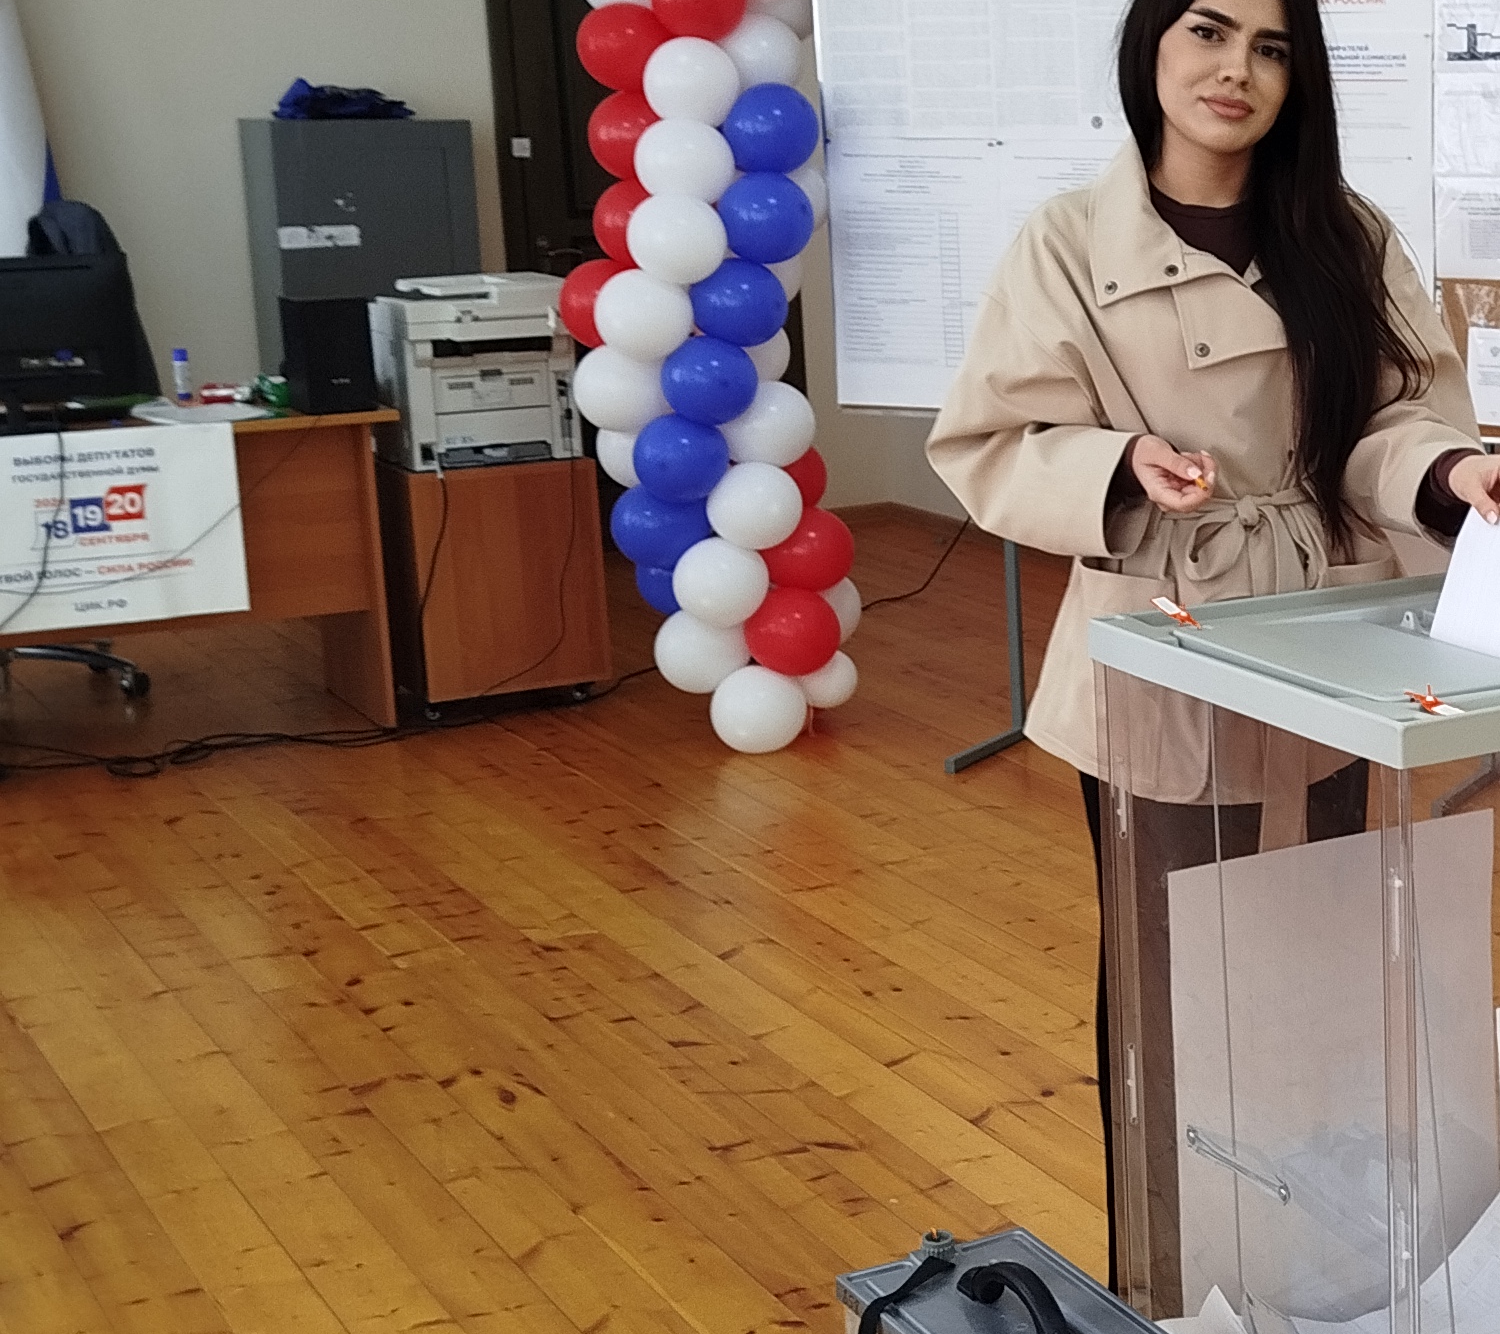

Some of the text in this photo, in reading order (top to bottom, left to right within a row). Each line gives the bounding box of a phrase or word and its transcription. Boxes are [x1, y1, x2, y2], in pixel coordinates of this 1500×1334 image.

[13, 447, 155, 467] ВЫБОРЫ ДЕПУТАТОВ
[12, 467, 124, 483] ГОСУДАРСТВЕННОЙ
[41, 491, 141, 539] 18 19 20
